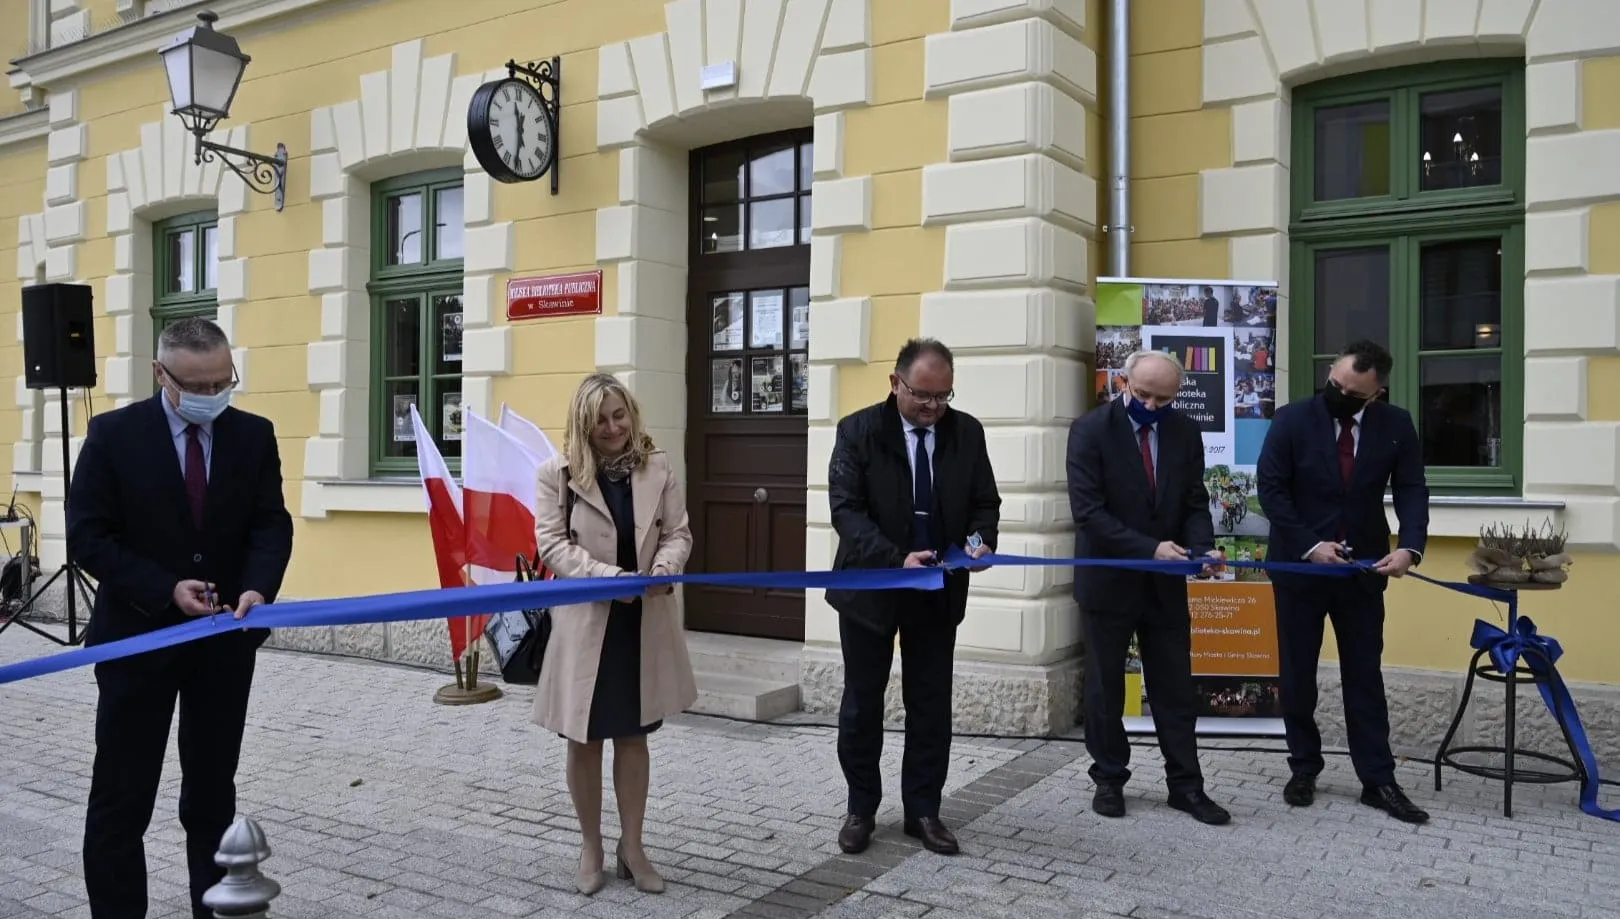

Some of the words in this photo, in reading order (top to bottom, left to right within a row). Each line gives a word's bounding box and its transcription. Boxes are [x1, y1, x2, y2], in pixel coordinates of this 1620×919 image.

[538, 300, 575, 310] Skawinie
[1188, 412, 1215, 422] winie
[1190, 627, 1261, 636] blioteka-skawina.pl
